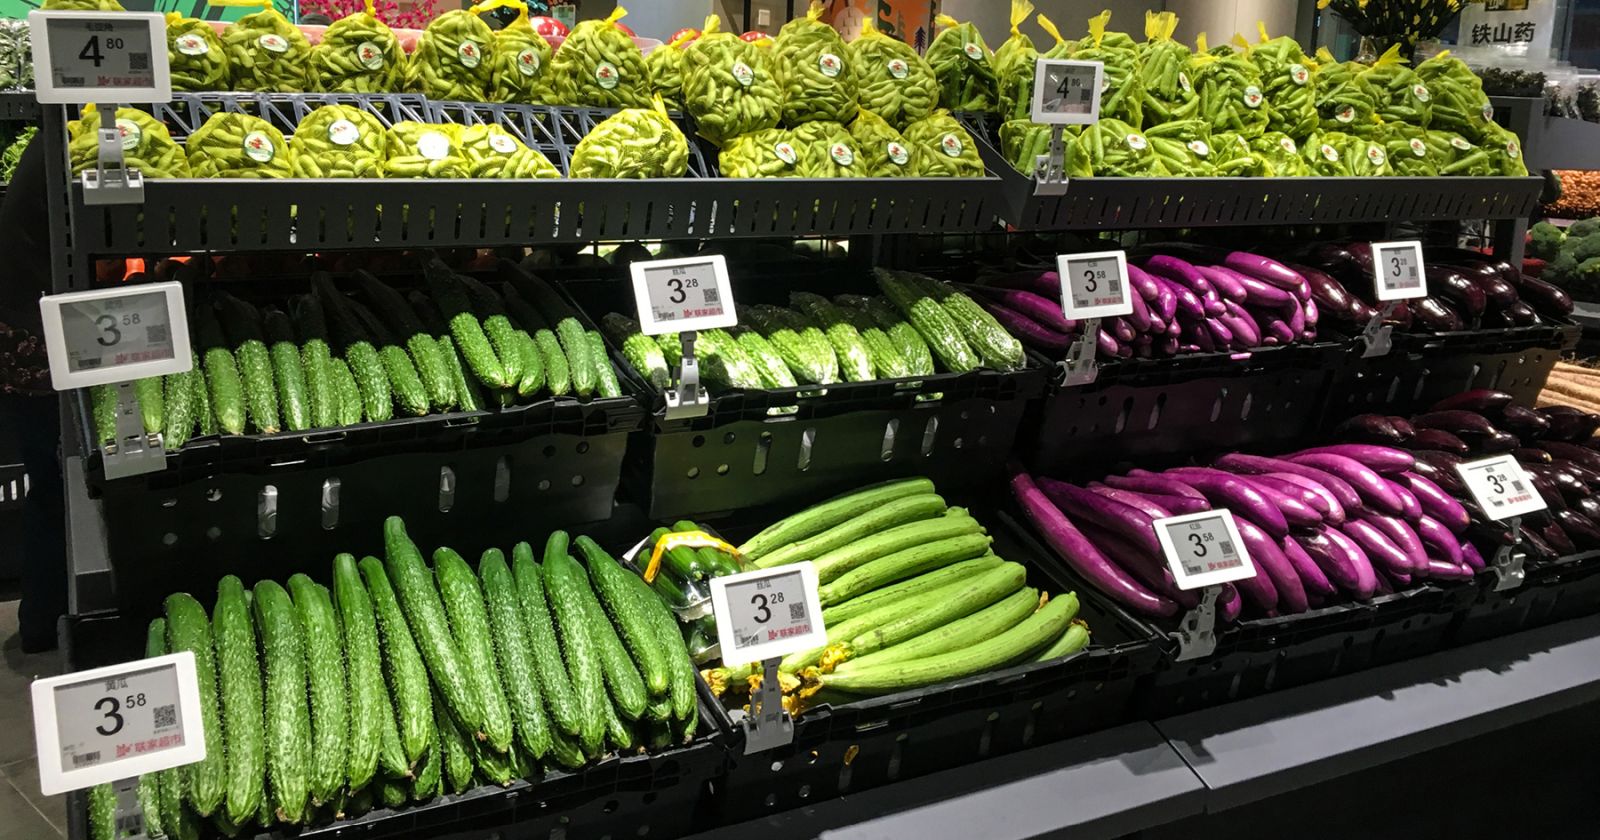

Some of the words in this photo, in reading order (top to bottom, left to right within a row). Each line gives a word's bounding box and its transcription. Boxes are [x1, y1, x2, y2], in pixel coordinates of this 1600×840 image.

[1471, 22, 1536, 44] 铁山药
[78, 35, 105, 68] 4
[106, 38, 124, 50] 80
[1056, 76, 1070, 99] 4
[1391, 257, 1401, 277] 3
[667, 278, 687, 304] 3
[685, 278, 699, 289] 28
[1083, 270, 1097, 293] 3
[1097, 270, 1106, 279] 58
[94, 314, 122, 347] 3
[122, 312, 141, 326] 58
[1486, 475, 1505, 495] 3
[1188, 533, 1207, 558] 3
[1202, 532, 1215, 542] 58
[750, 593, 772, 624] 3
[770, 591, 785, 605] 28
[104, 677, 129, 692] 黄瓜
[93, 696, 125, 737] 3
[125, 692, 147, 709] 58
